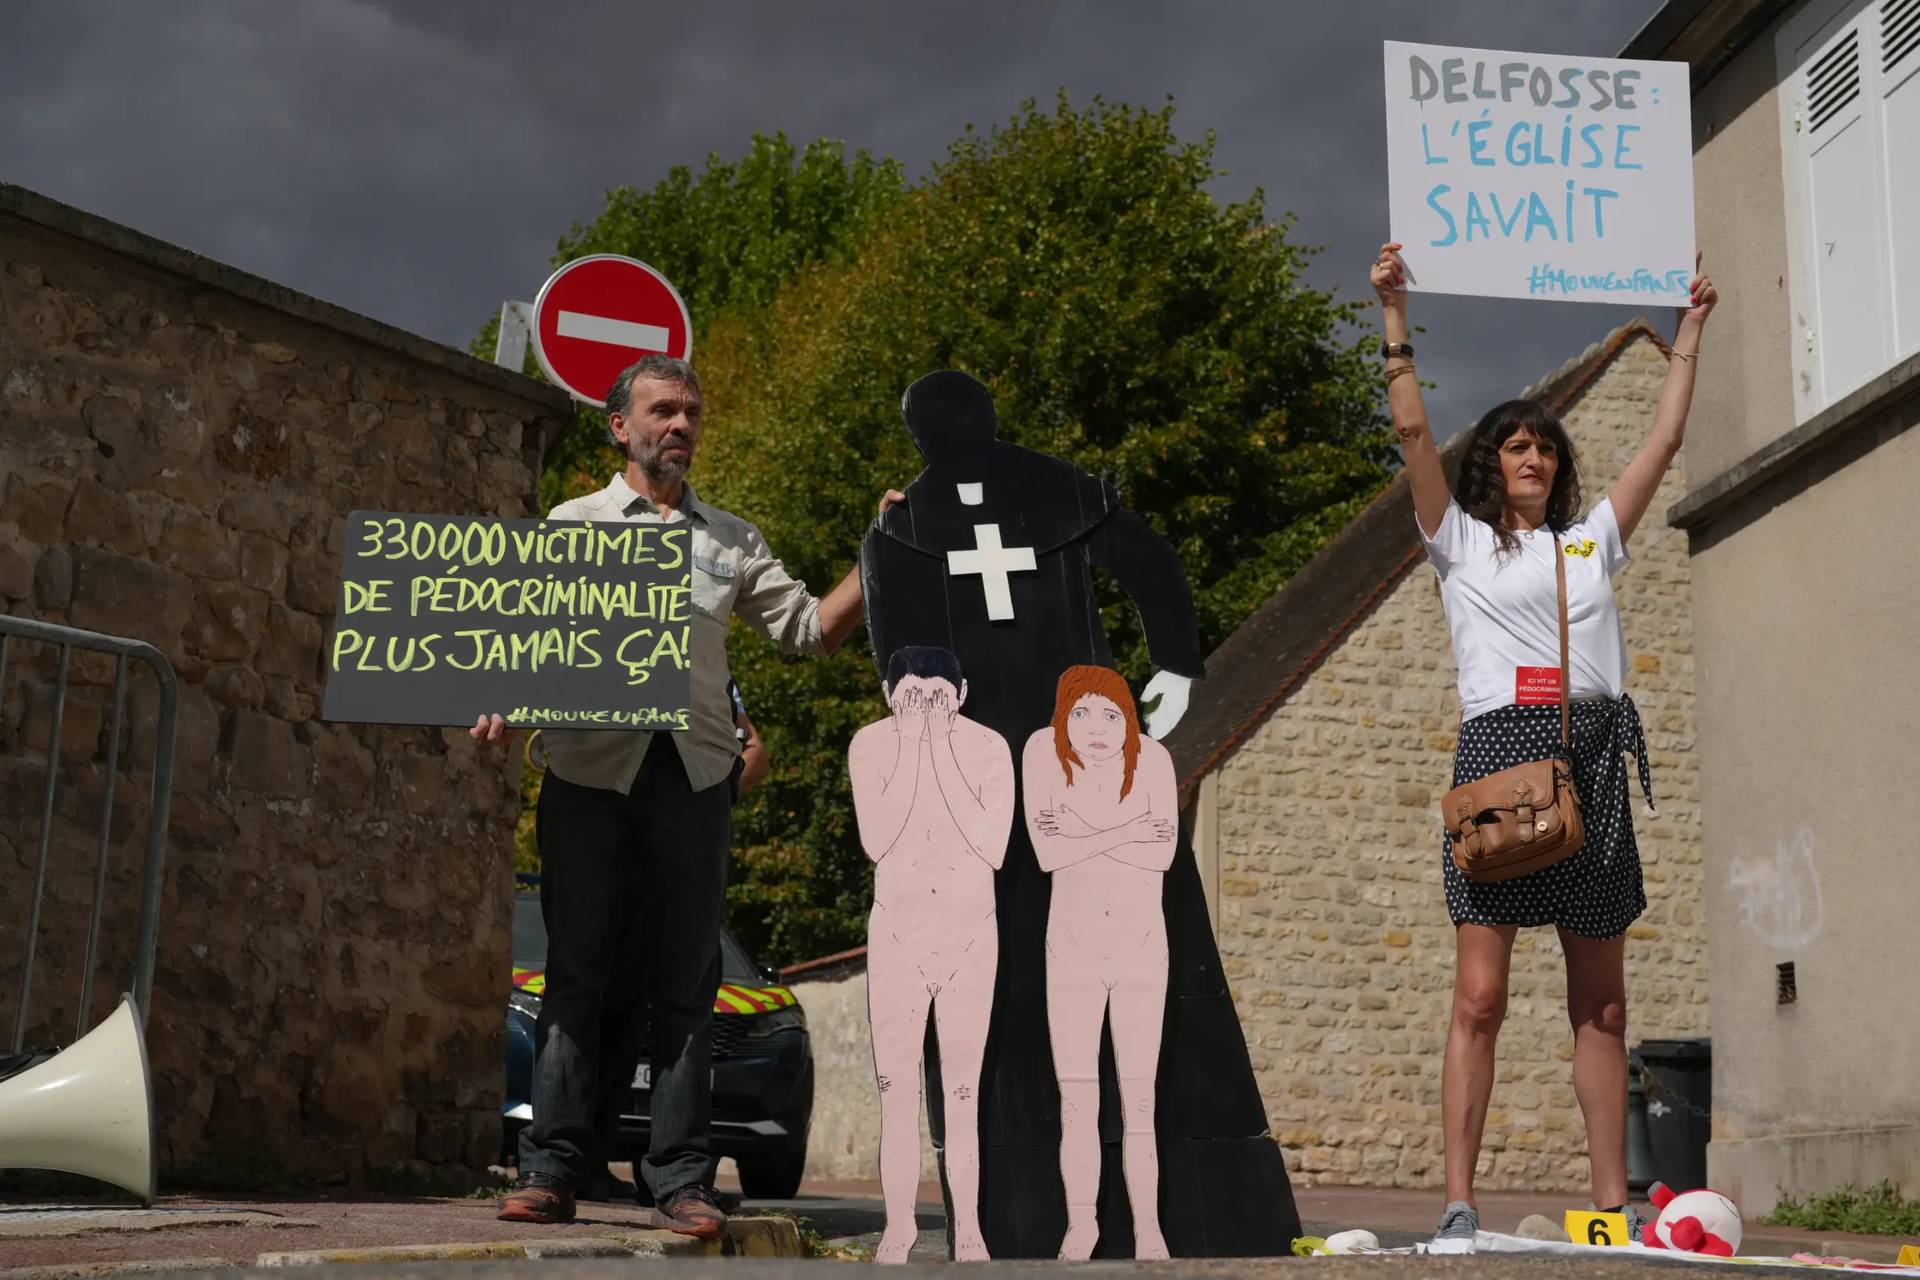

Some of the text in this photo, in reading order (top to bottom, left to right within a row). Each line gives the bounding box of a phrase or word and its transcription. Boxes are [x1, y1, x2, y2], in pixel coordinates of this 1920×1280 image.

[1422, 108, 1642, 170] L'ÉGLISE
[1427, 180, 1619, 247] SAVAIT
[357, 518, 688, 570] 330000 VICTIMES
[343, 565, 691, 623] DE PÉDOCRIMINALITÉ
[332, 621, 691, 686] PLUS JAMAIS ÇA!
[1588, 1218, 1611, 1246] 6
